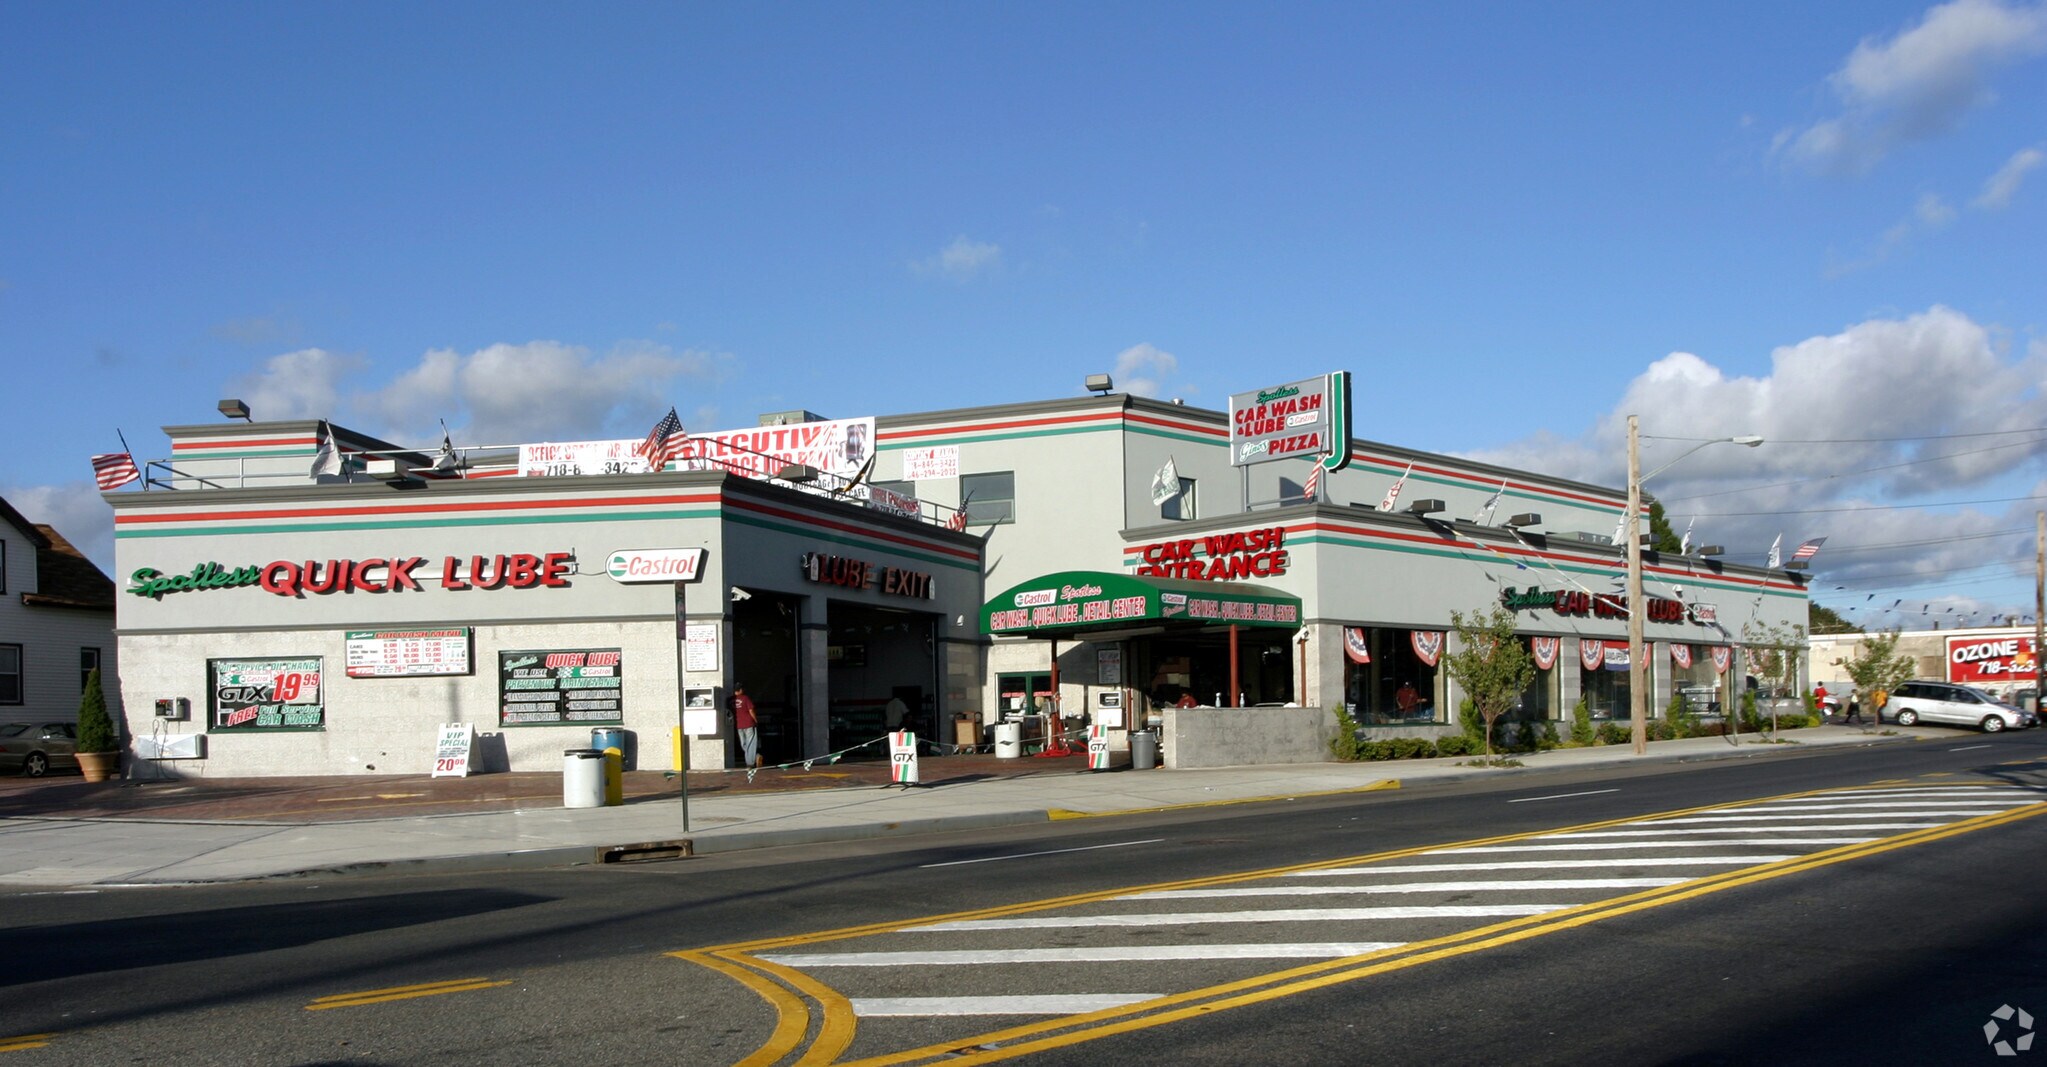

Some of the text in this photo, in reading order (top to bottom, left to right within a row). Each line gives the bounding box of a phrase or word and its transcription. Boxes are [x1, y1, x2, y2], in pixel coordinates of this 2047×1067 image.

[1256, 386, 1300, 405] Spotless
[1235, 394, 1323, 425] CAR WASH
[1294, 413, 1318, 424] Castrol
[1268, 433, 1320, 456] PIZZA
[1143, 526, 1285, 565] CAR WASH
[126, 552, 573, 599] Spotless QUICK LUBE
[628, 554, 696, 577] Castrol
[819, 553, 930, 599] LUBE EXIT
[1023, 584, 1103, 605] Castrol Spotless
[1505, 585, 1556, 609] Spotless
[990, 596, 1147, 631] CAR WASH QUICK LUBE DETAIL CENTER
[1275, 604, 1297, 623] CENTER
[545, 652, 586, 670] QUICK
[587, 651, 621, 667] LUBE
[1952, 640, 2019, 664] OZONE
[513, 667, 612, 679] WE USE Castrol
[218, 685, 270, 703] GTX
[226, 704, 260, 727] FREE
[256, 712, 321, 726] CAR WASH
[439, 739, 469, 747] SPECIAL
[446, 731, 464, 739] VIP
[1090, 743, 1107, 752] GTX
[893, 753, 914, 763] GTX
